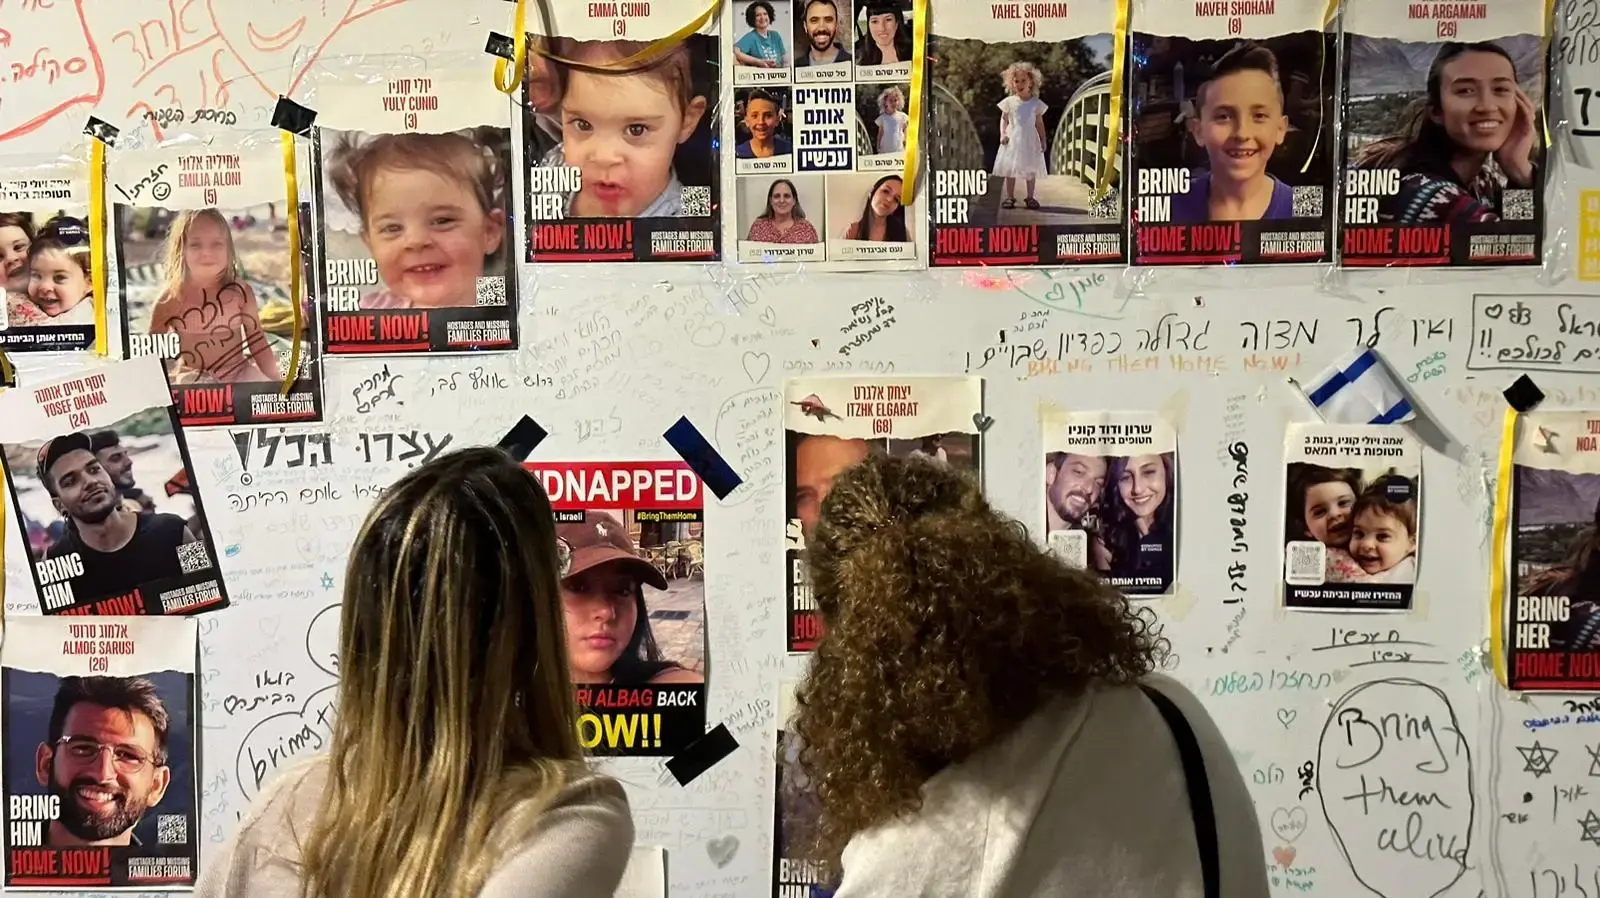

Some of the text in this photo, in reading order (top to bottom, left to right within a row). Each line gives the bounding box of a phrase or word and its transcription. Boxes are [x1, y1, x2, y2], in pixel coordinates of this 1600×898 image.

[588, 2, 651, 18] EMMA CUNIO
[991, 3, 1067, 19] YAHEL SHOHAM
[1195, 0, 1275, 17] NAVEH SHOHAM
[1408, 4, 1487, 19] NOA ARGAMANI
[612, 19, 626, 37] (3)
[1022, 20, 1036, 38] (3)
[1228, 18, 1242, 35] (8)
[1436, 21, 1457, 38] (26)
[894, 68, 909, 76] עדי
[388, 78, 432, 97] יולי קוניו
[795, 87, 852, 105] מחזירים
[382, 95, 438, 112] YULY CUNIO
[404, 113, 418, 129] (3)
[803, 108, 845, 125] אותם
[800, 130, 849, 145] הביתה
[178, 156, 241, 171] אמיליה אלוני
[801, 150, 848, 167] עכשיו
[178, 171, 242, 188] EMILIA ALONI
[530, 166, 583, 192] BRING
[935, 169, 988, 196] BRING
[1138, 167, 1191, 195] BRING
[1345, 168, 1400, 196] BRING
[203, 188, 218, 206] (5)
[531, 193, 565, 220] HER
[935, 197, 969, 224] HER
[1138, 195, 1171, 222] HIM
[1344, 197, 1379, 224] HER
[532, 220, 634, 251] HOME NOW!
[937, 223, 1038, 255] HOME NOW!
[1139, 221, 1241, 252] HOME NOW!
[1344, 223, 1451, 256] HOME NOW!
[651, 239, 714, 253] FAMILIES FORUM
[1057, 241, 1121, 256] FAMILIES FORUM
[326, 258, 379, 285] BRING
[327, 286, 361, 312] HER
[328, 312, 430, 342] HOME NOW!
[446, 321, 473, 329] HOSTAGES
[474, 320, 485, 328] AND
[1136, 312, 1211, 352] גדולה
[1346, 306, 1396, 349] לך
[1412, 318, 1453, 347] ואין
[7, 335, 35, 345] הביתה
[36, 334, 57, 345] אותן
[58, 333, 85, 344] החזירו
[447, 327, 511, 342] FAMILIES FORUM
[1240, 318, 1319, 350] מצוה
[129, 331, 181, 360] BRING
[1057, 331, 1122, 361] כפדיון
[1108, 354, 1159, 373] THEM
[1171, 353, 1226, 373] HOME
[33, 376, 107, 404] יוסף חיים אוחנה
[853, 385, 911, 403] יצחק אלגרט
[43, 390, 108, 419] YOSEF OHANA
[184, 384, 234, 415] NOW!
[846, 402, 919, 418] ITZHK ELGARAT
[68, 410, 90, 430] (24)
[872, 418, 893, 435] (68)
[1068, 424, 1153, 437] שרון ודוד קוניו
[1067, 436, 1153, 446] חטופים בידי חמאס
[1312, 436, 1334, 445] בנות
[1361, 437, 1381, 445] ויולי
[1383, 437, 1404, 445] אמה
[1576, 437, 1597, 452] NOA
[1304, 446, 1404, 457] חטופות בידי חמאס
[299, 482, 342, 505] אותם
[559, 511, 698, 522] Israeli #BringThemHome
[35, 552, 85, 586] BRING
[1111, 577, 1163, 586] החזירו אותם
[42, 581, 76, 610] HIM
[1294, 590, 1402, 601] החזירו אותן הביתה עכשיו
[1517, 595, 1571, 622] BRING
[69, 624, 129, 639] אלמוג סרוסי
[1515, 623, 1551, 649] HER
[62, 640, 135, 655] ALMOG SARUSI
[88, 656, 109, 673] (26)
[1514, 652, 1564, 678] HOME
[593, 688, 698, 707] ALBAG BACK
[1335, 707, 1450, 774] Bring
[1342, 774, 1452, 816] them
[9, 795, 61, 820] BRING
[10, 821, 42, 847] HIM
[1376, 811, 1477, 871] alive
[10, 846, 112, 877] HOME NOW!
